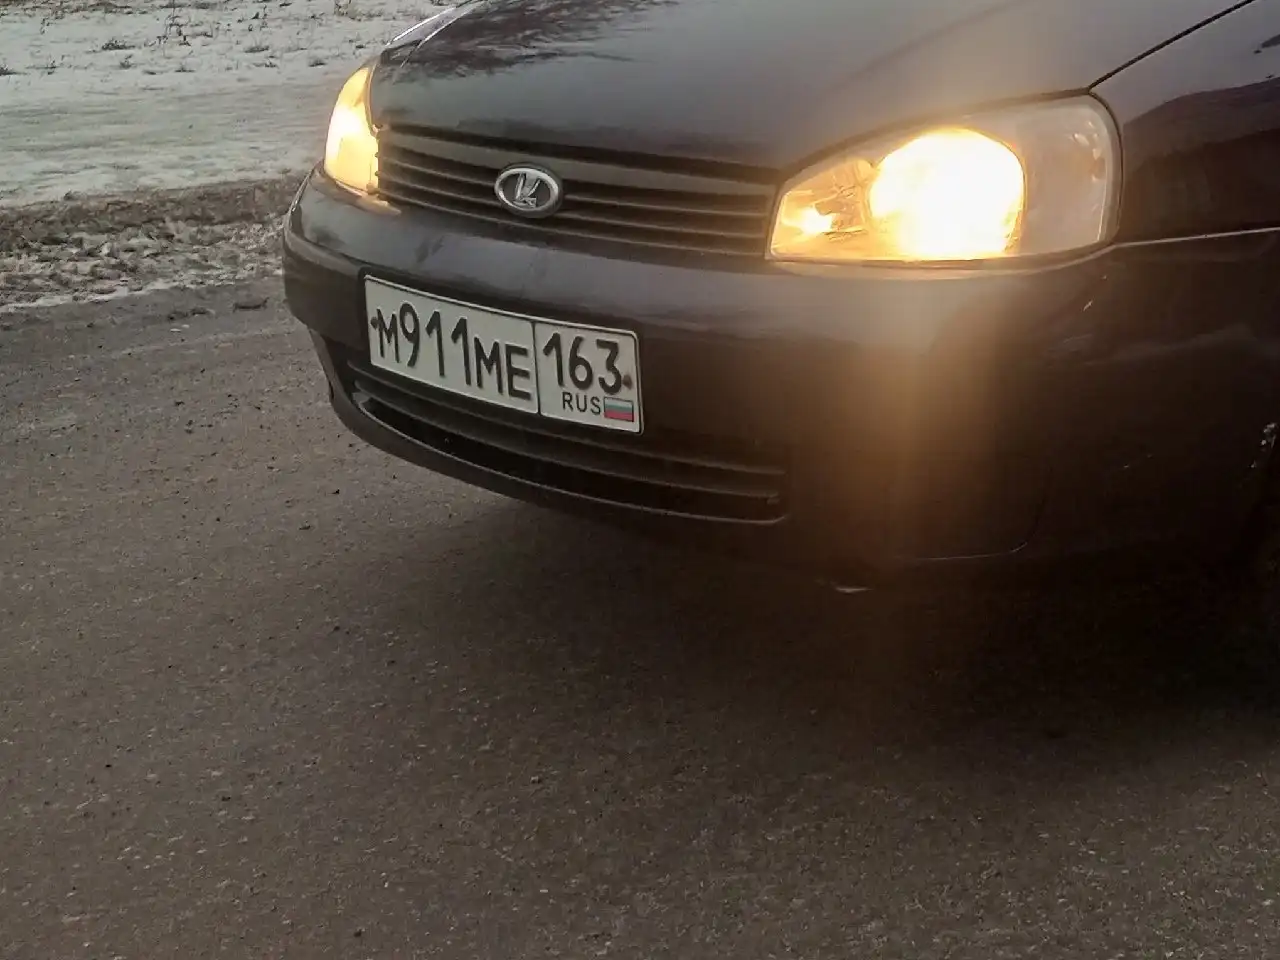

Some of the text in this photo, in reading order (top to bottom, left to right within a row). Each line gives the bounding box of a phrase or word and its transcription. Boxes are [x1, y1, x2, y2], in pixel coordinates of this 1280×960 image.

[375, 300, 622, 400] М911МЕ 163
[561, 391, 602, 415] RUS
